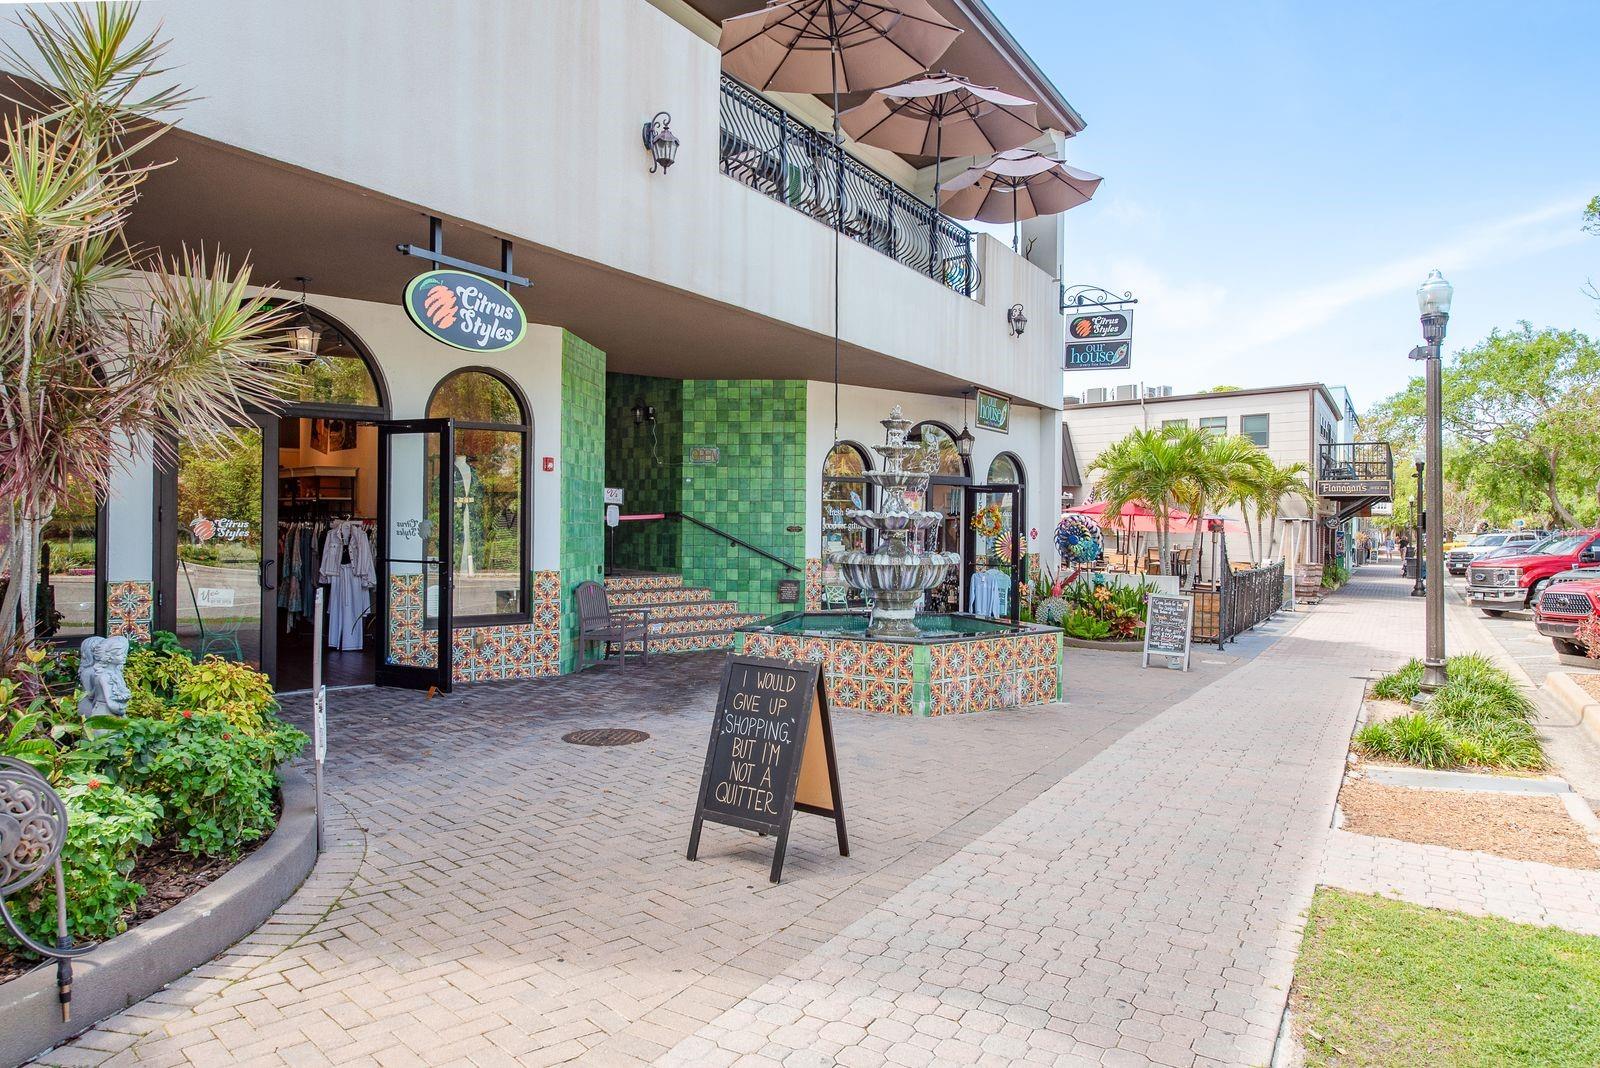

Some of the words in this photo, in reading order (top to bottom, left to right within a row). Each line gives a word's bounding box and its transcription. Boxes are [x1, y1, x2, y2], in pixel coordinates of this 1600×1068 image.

[456, 286, 514, 320] Citrus
[460, 309, 514, 346] Styles
[1092, 316, 1119, 325] Citrus
[1093, 325, 1119, 336] Styles
[1070, 348, 1114, 364] house
[1086, 344, 1106, 352] our
[980, 397, 1001, 422] house
[692, 448, 720, 462] OPEN
[1320, 483, 1368, 493] Flanagan's
[214, 518, 250, 528] Citrus
[216, 528, 250, 540] Styles
[742, 670, 748, 688] I
[758, 672, 796, 692] WOULD
[733, 692, 760, 712] GIVE
[770, 698, 788, 716] UP
[732, 737, 756, 759] BUT
[762, 742, 781, 766] I'M
[730, 761, 755, 783] NOT
[760, 767, 771, 788] A
[716, 782, 778, 814] QUITTER
